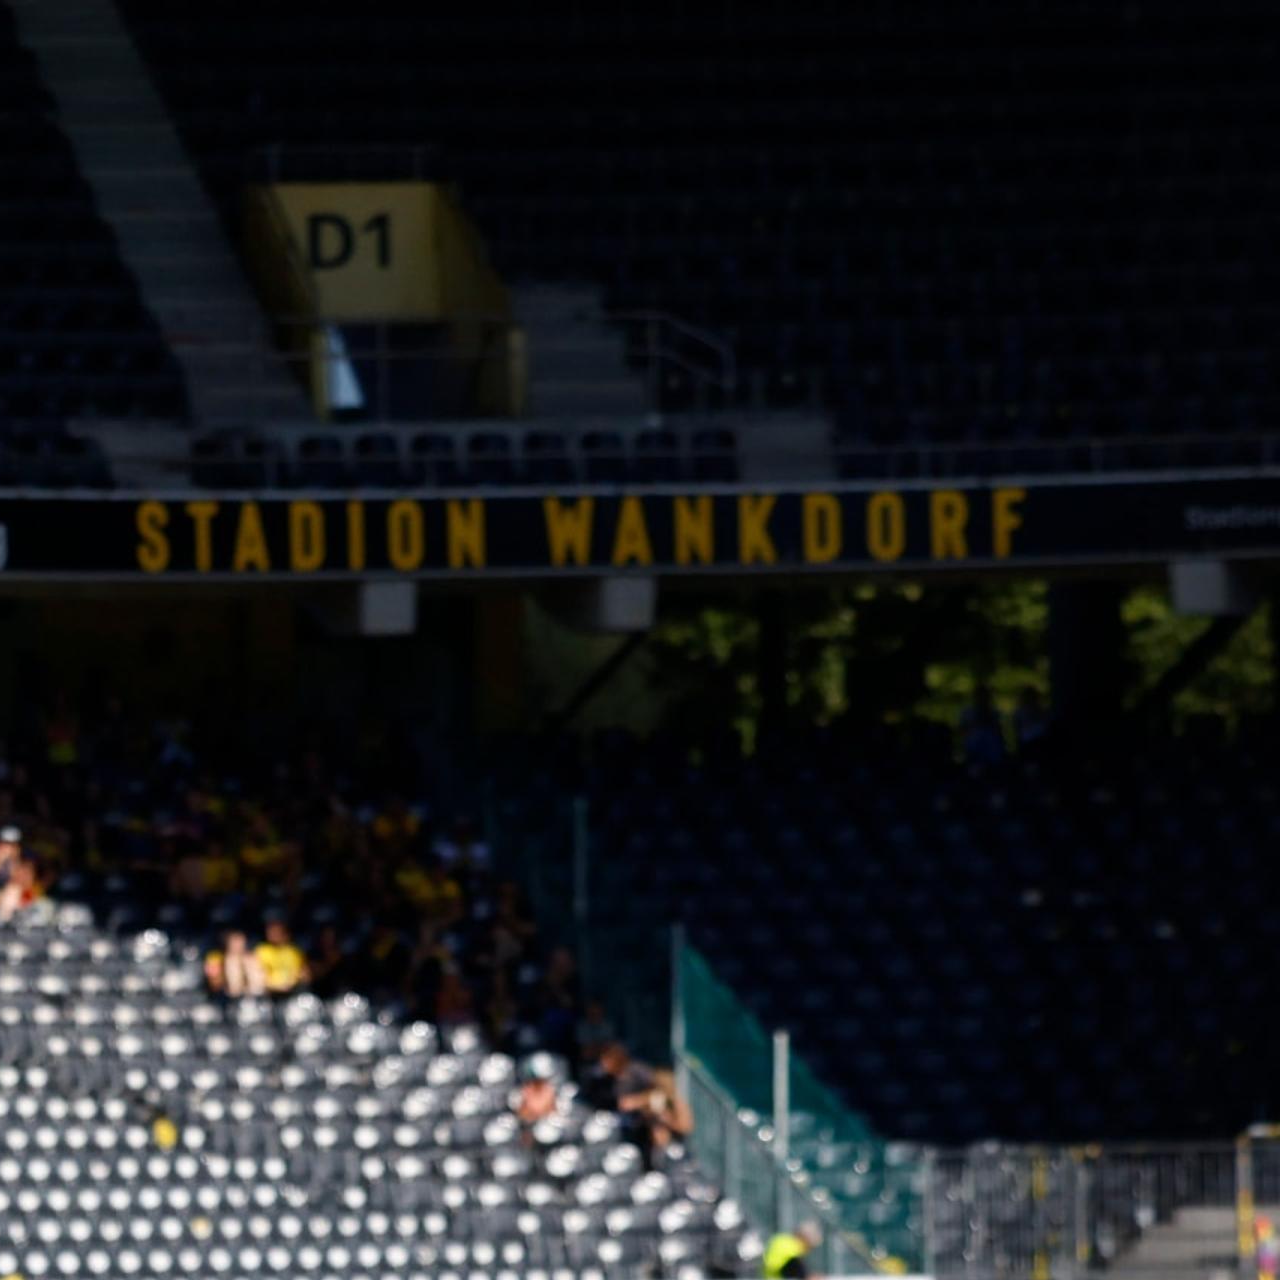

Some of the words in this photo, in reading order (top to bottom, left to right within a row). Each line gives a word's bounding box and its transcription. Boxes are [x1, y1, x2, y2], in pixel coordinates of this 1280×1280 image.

[307, 212, 392, 268] D1
[136, 499, 485, 572] STADION
[543, 487, 1026, 565] WANKDORF
